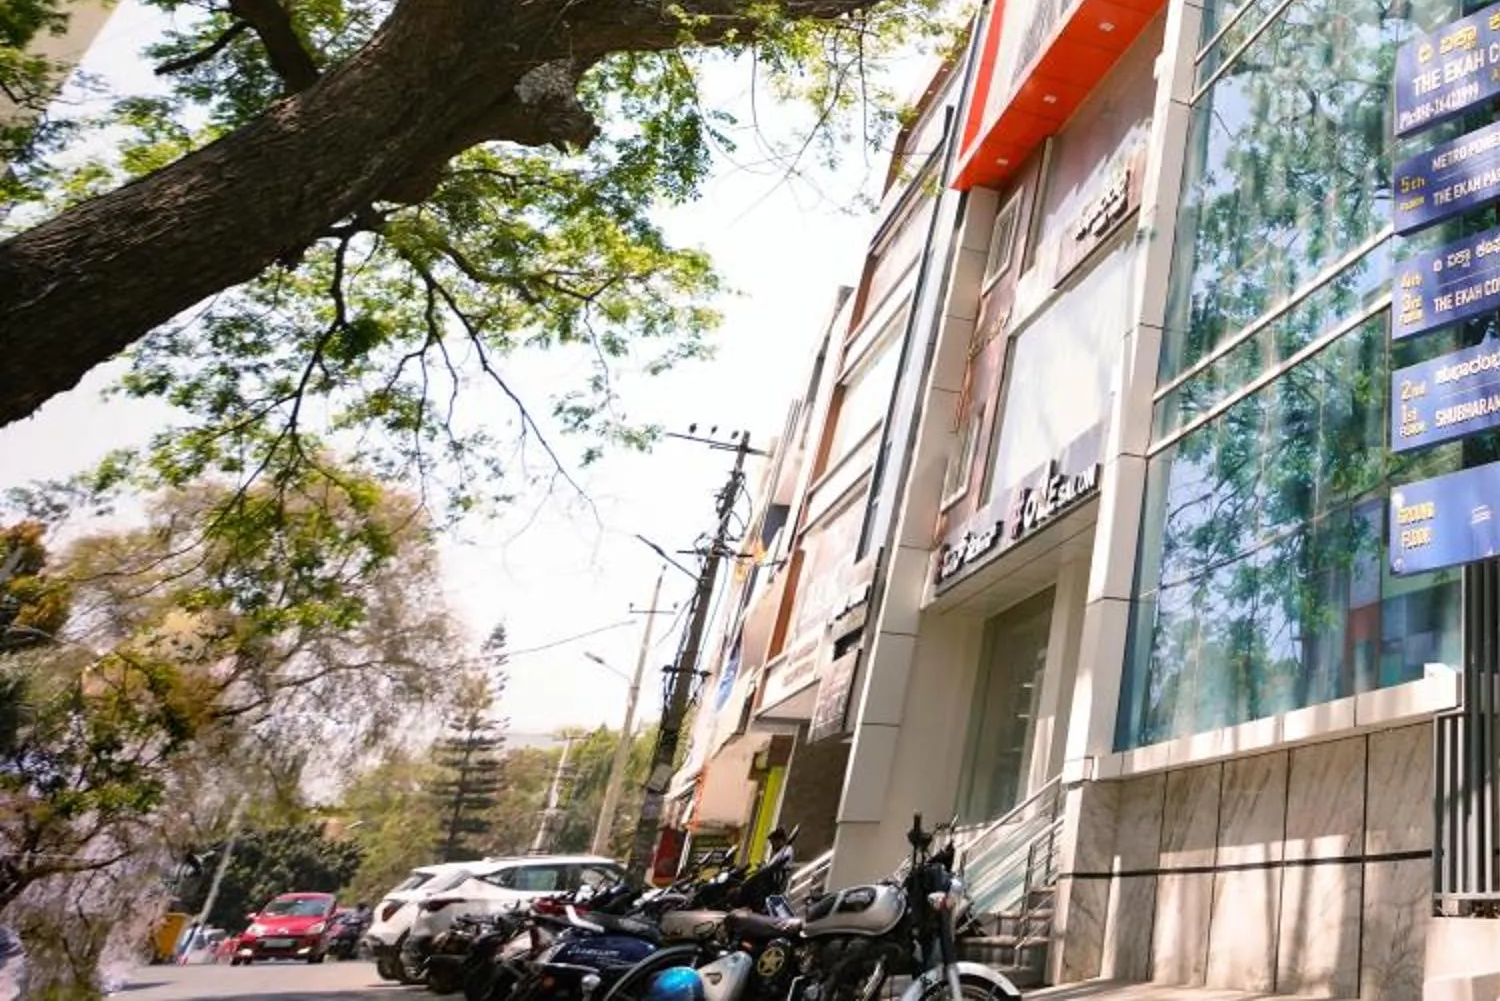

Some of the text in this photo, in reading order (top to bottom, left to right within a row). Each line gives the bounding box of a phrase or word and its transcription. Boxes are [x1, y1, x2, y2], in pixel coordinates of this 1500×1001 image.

[1412, 68, 1441, 97] THE
[1443, 47, 1485, 84] EKAH
[1432, 148, 1467, 171] METRO
[1433, 189, 1453, 206] THE
[1453, 177, 1481, 200] EKAH
[1433, 295, 1453, 312] THE
[1455, 286, 1483, 306] EKAH
